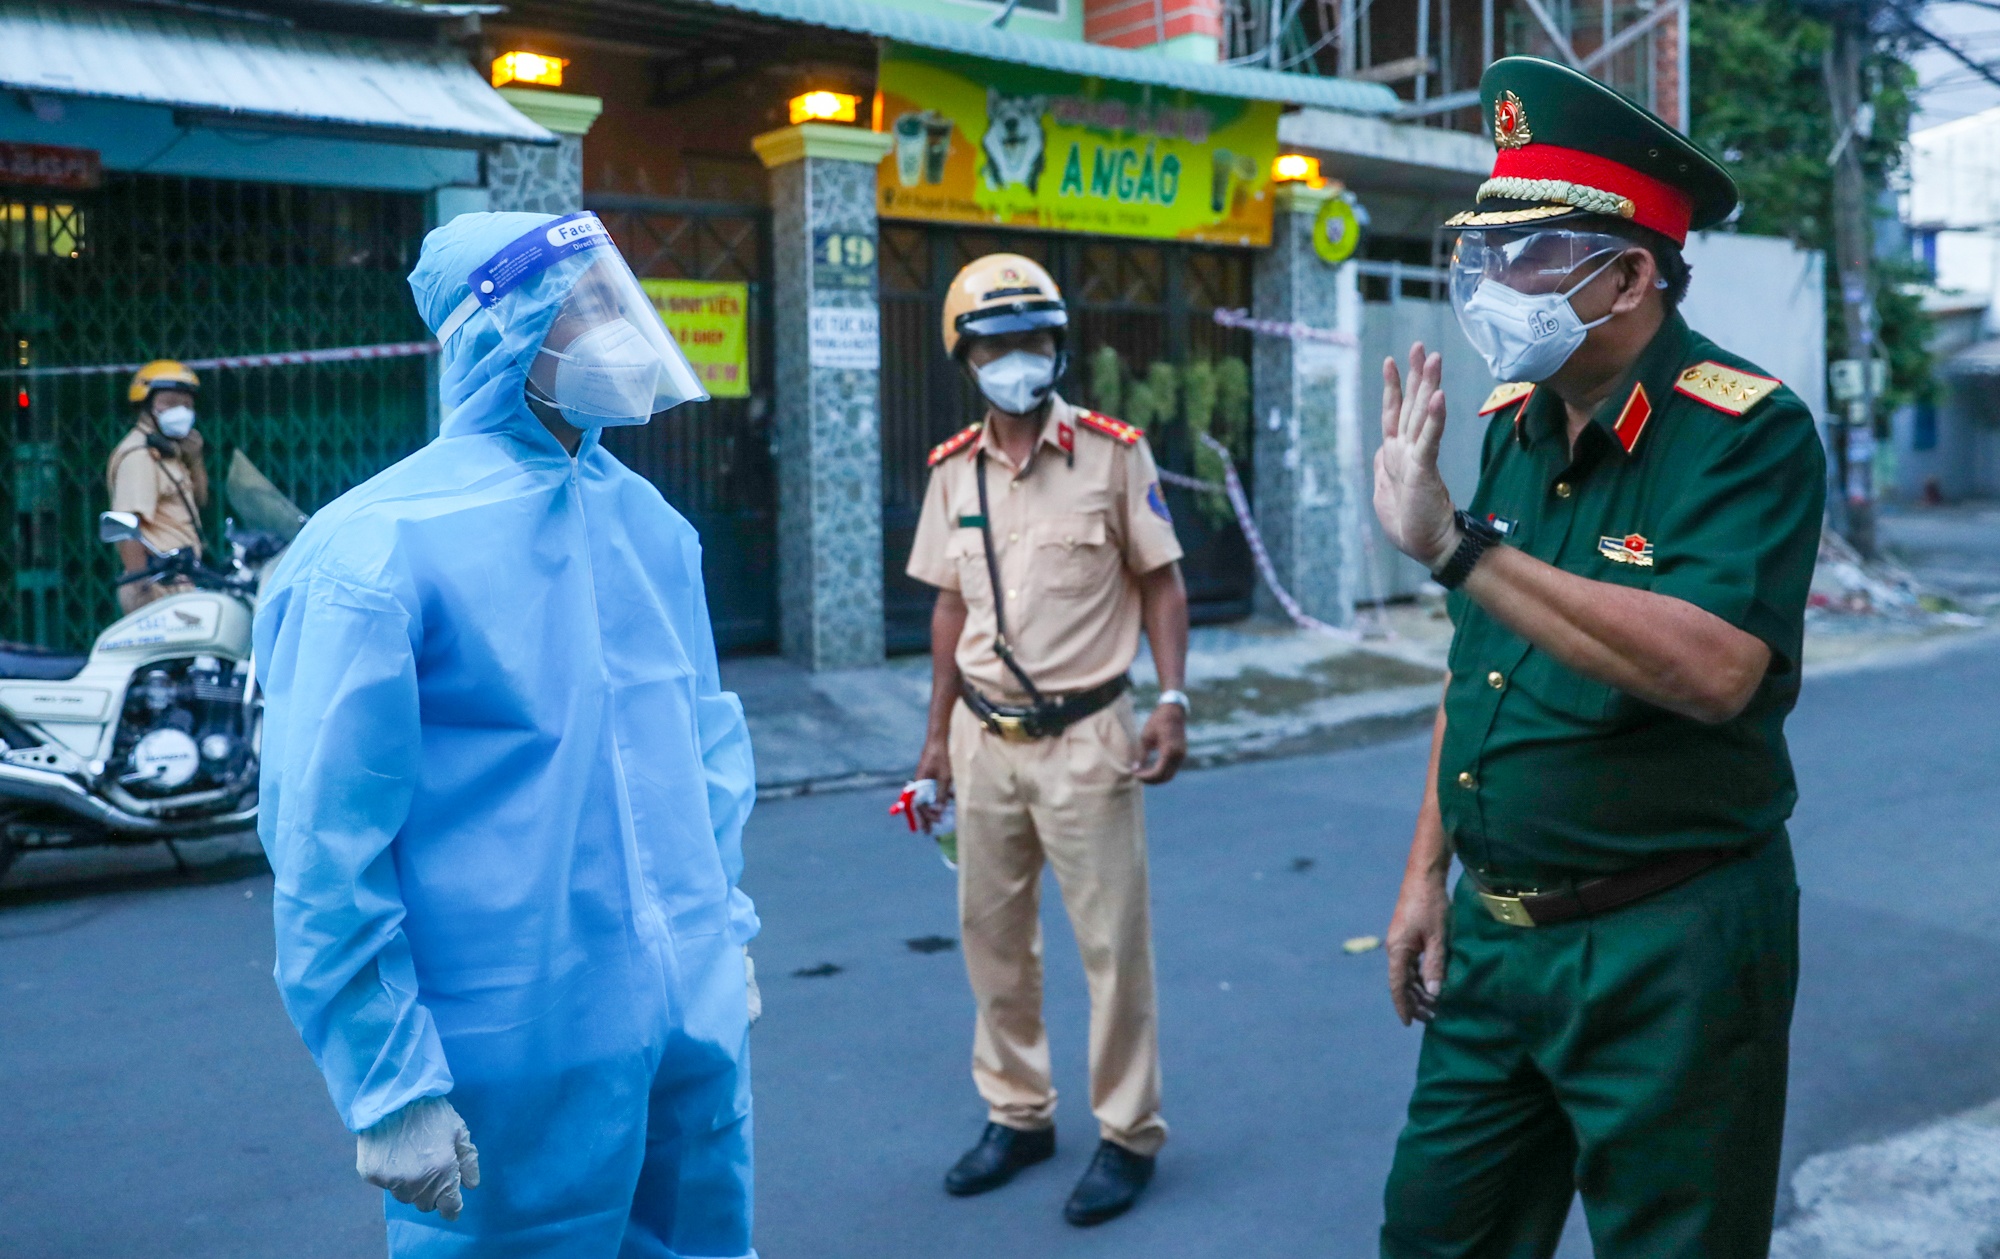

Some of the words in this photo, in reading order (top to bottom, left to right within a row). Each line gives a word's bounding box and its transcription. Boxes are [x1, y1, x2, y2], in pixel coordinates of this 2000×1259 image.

[558, 223, 593, 240] Face
[572, 239, 594, 251] Direct
[825, 233, 876, 269] 19
